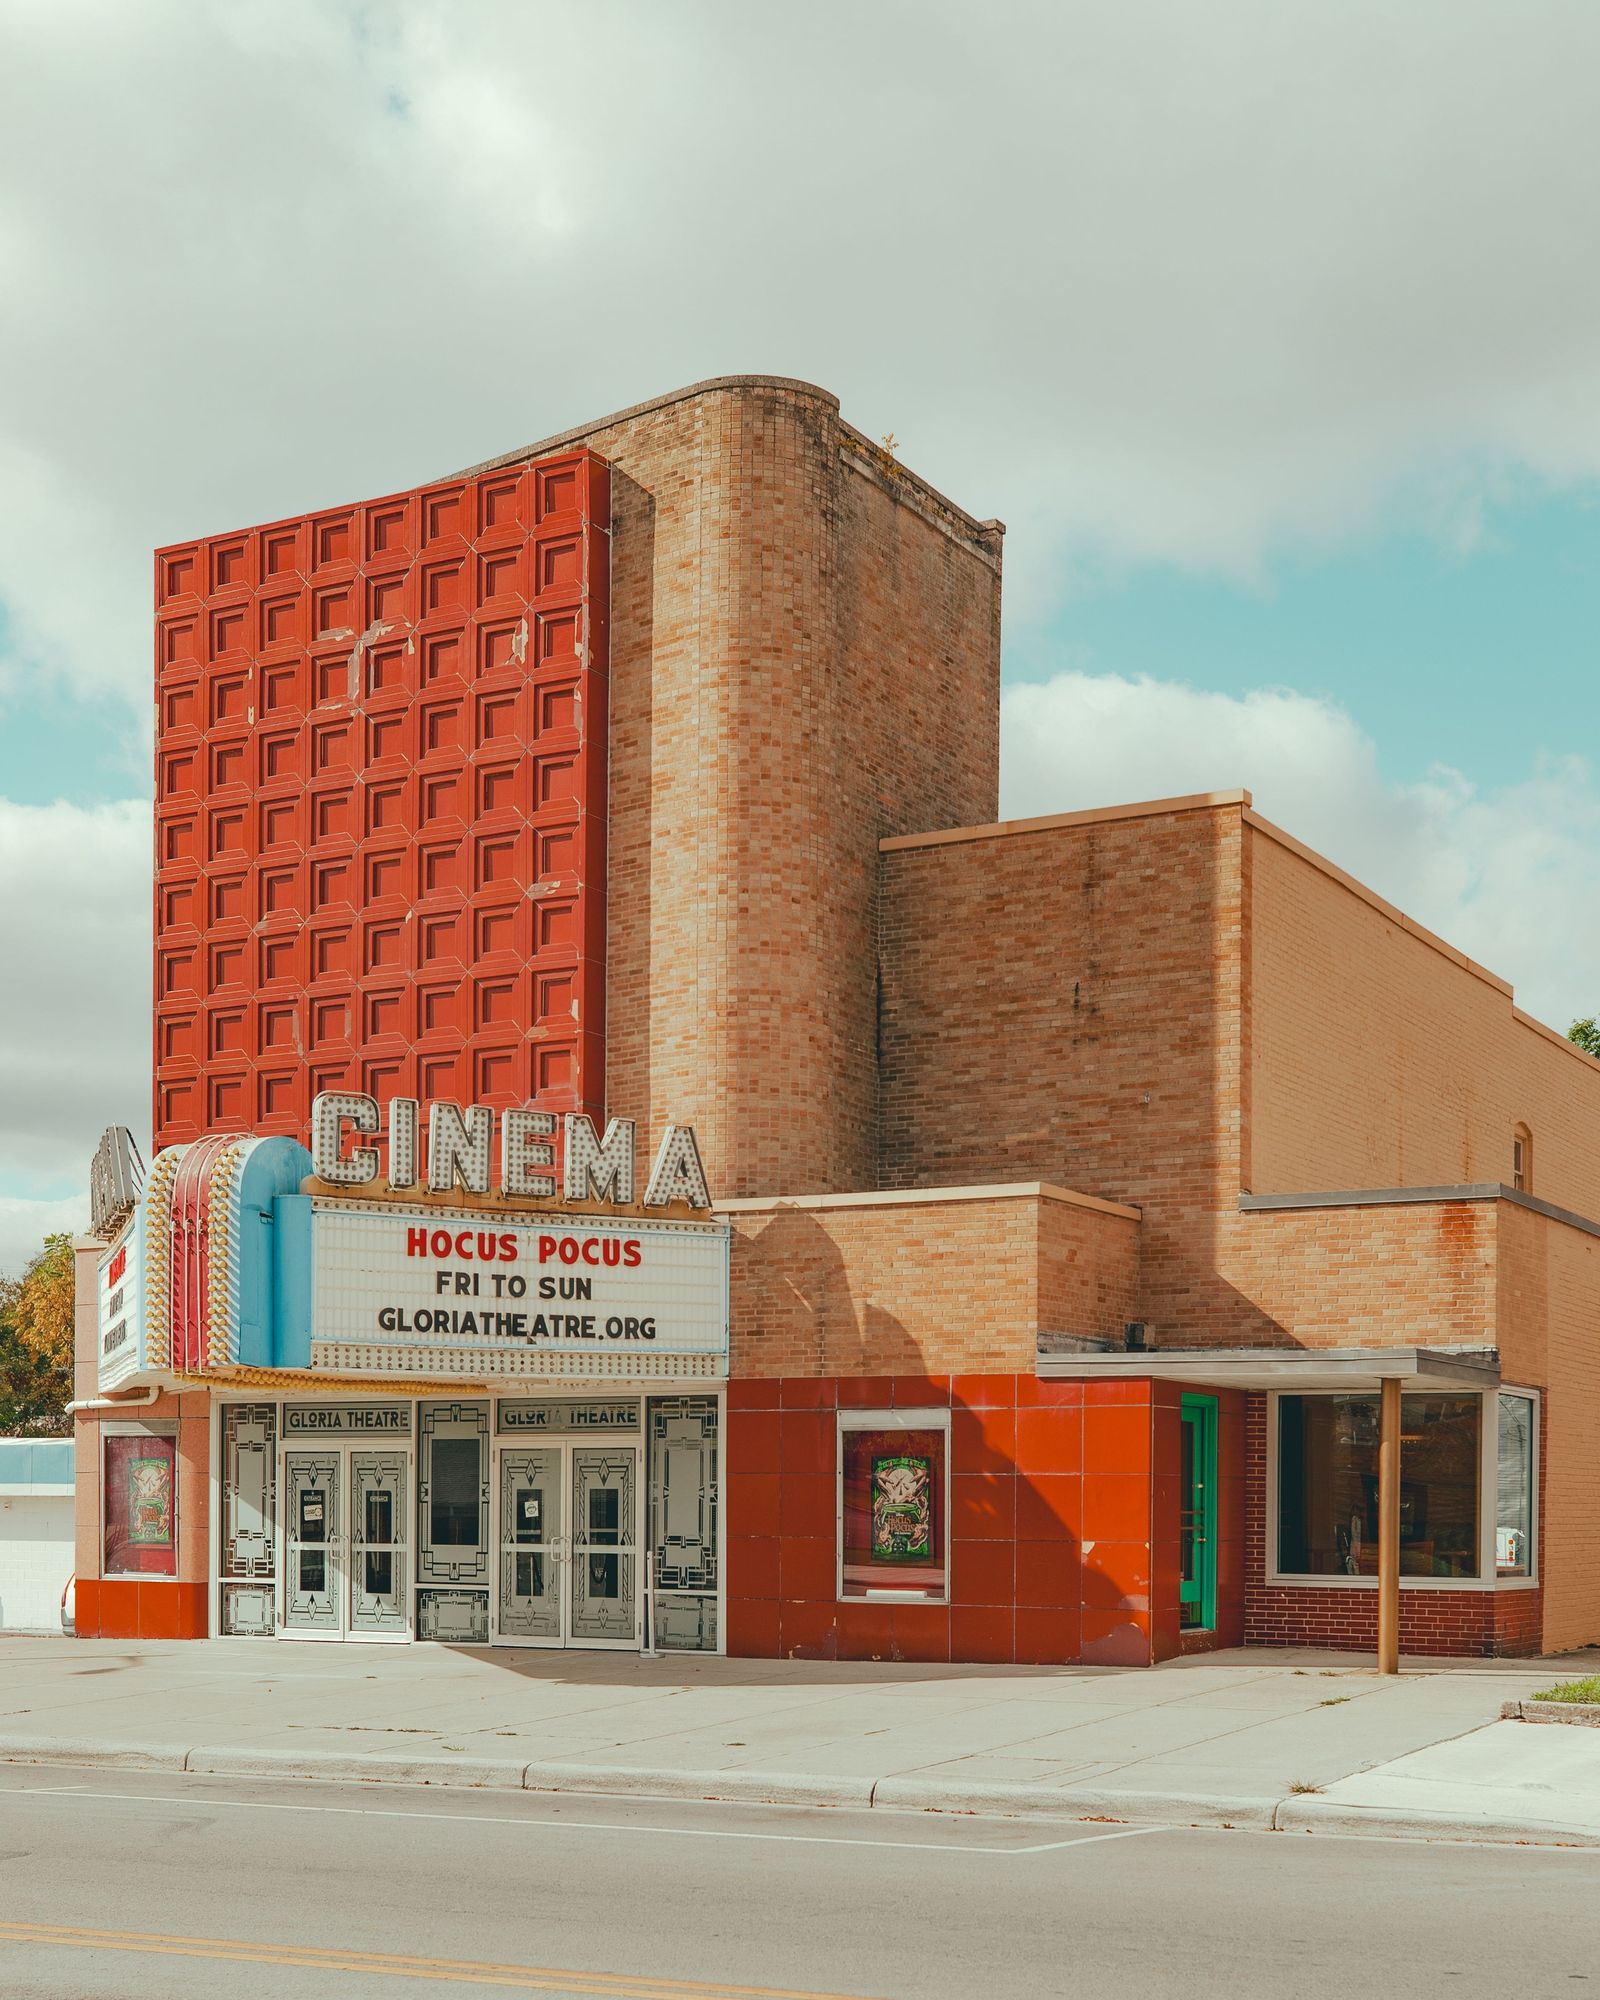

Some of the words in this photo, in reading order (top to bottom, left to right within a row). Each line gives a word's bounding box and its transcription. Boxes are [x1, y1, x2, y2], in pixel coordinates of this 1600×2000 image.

[311, 1089, 713, 1211] CINEMA
[407, 1227, 518, 1262] HOCUS
[538, 1235, 642, 1267] POCUS
[436, 1270, 480, 1296] FRI
[491, 1274, 527, 1298] TO
[538, 1277, 592, 1300] SUN
[378, 1307, 656, 1340] GLORIATHEATRE.ORG
[289, 1411, 342, 1428] GLORIA
[347, 1410, 409, 1428] THEATRE
[569, 1405, 637, 1424] THEATRE
